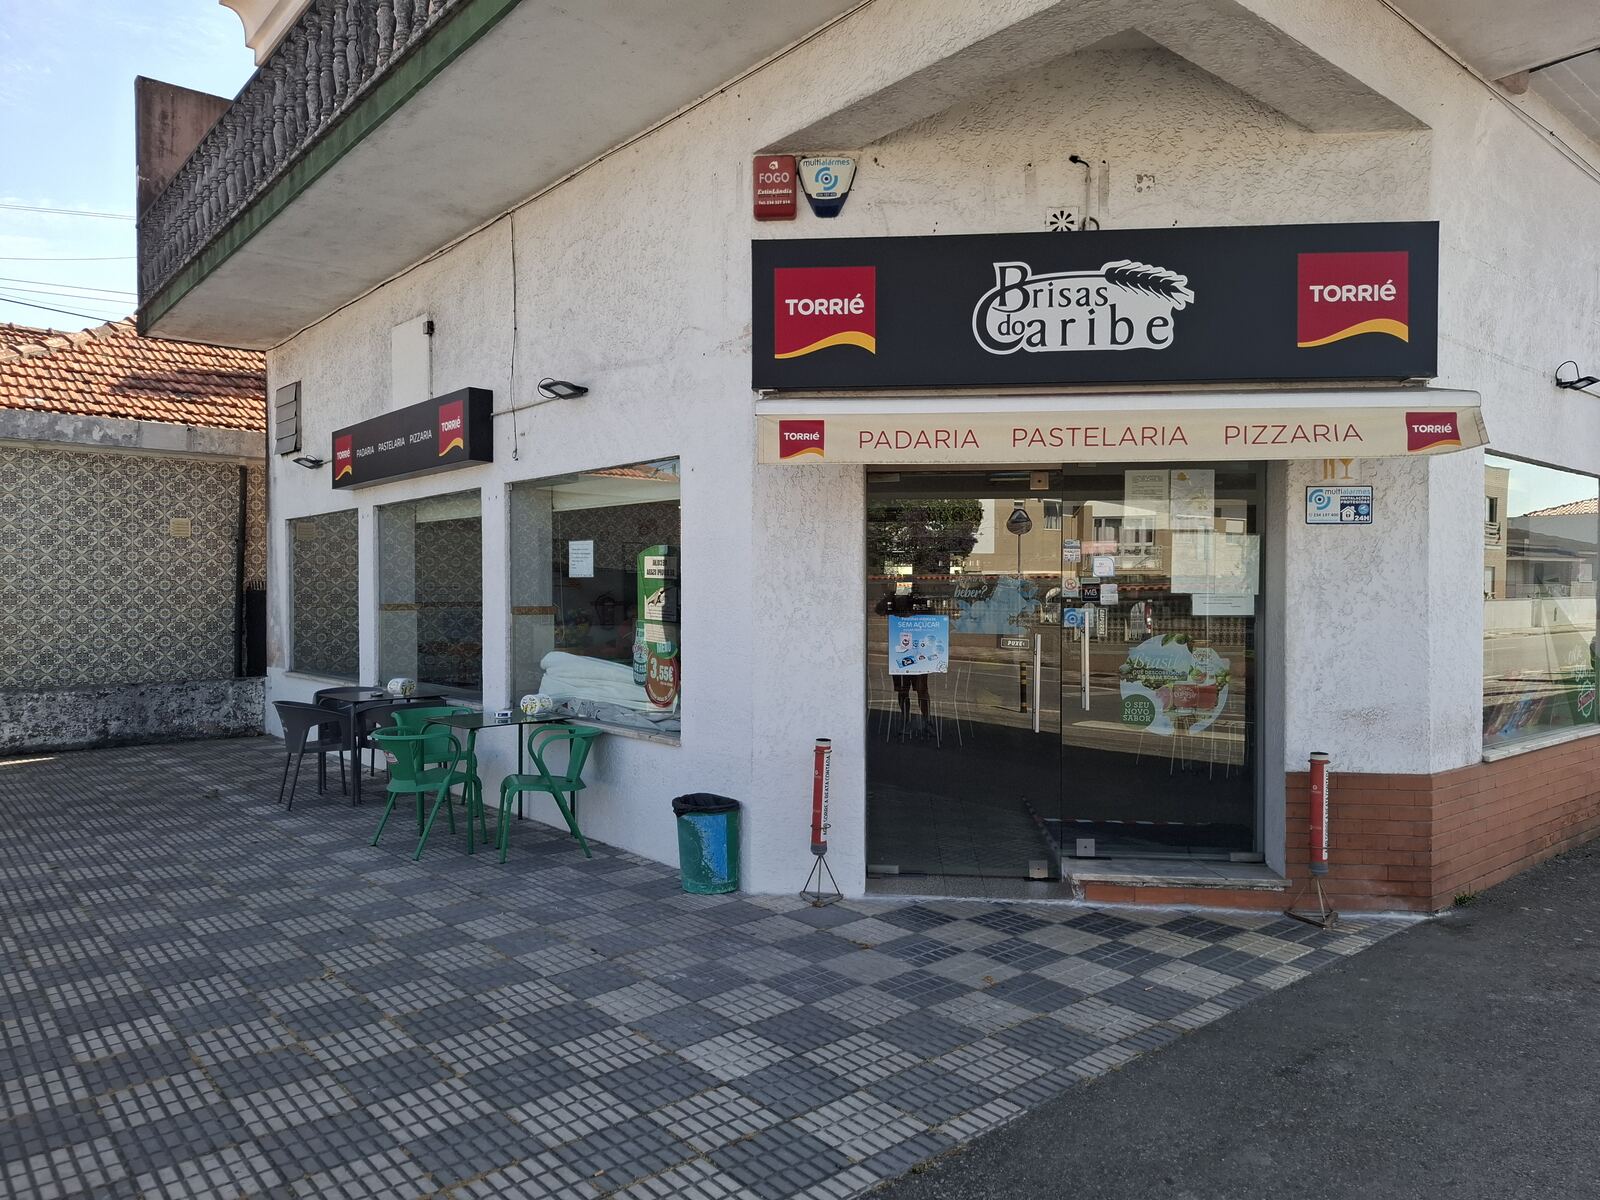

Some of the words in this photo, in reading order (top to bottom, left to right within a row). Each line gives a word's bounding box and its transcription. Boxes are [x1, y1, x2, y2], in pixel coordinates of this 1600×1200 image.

[803, 158, 850, 167] multialarmes
[759, 172, 790, 184] FOGO
[992, 265, 1110, 313] Brisas
[976, 290, 1170, 351] Caribe
[997, 313, 1026, 336] do
[356, 445, 375, 459] PADARIA
[378, 437, 406, 452] PASTELARIA
[409, 430, 433, 444] PIZZARIA
[859, 429, 980, 450] PADARIA
[1012, 426, 1188, 448] PASTELARIA
[1224, 423, 1364, 446] PIZZARIA
[1324, 488, 1371, 496] multialarmes
[954, 585, 988, 597] beber?
[1084, 588, 1097, 597] MB
[650, 657, 674, 683] 3,55€
[1125, 701, 1131, 709] O
